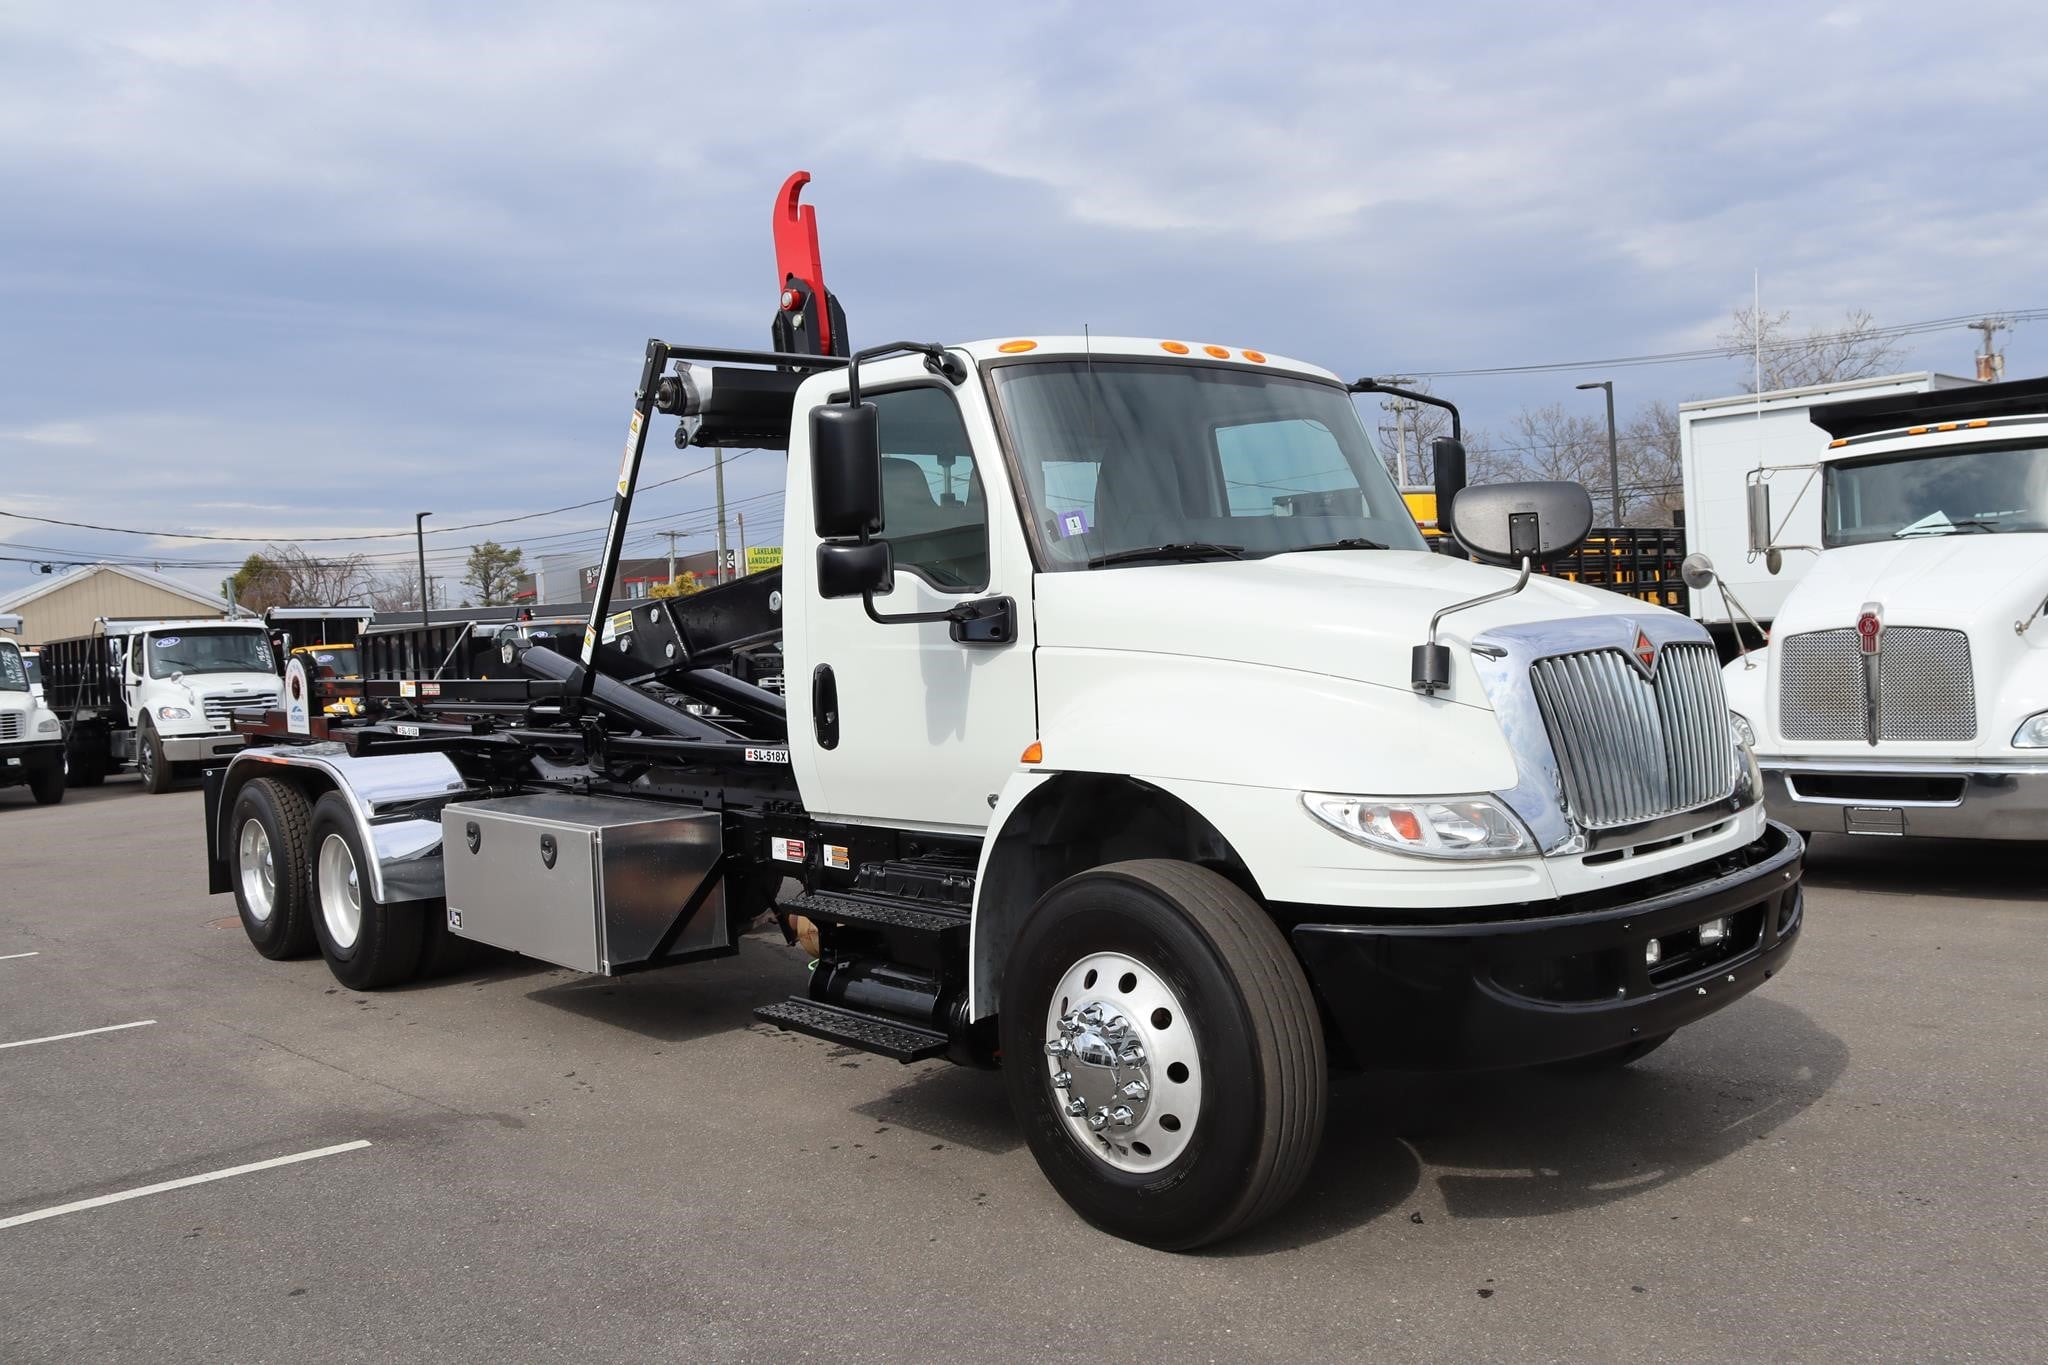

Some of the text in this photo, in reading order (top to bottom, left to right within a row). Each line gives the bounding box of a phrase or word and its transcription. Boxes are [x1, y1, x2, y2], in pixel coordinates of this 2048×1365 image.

[753, 547, 781, 555] LAKELAND
[748, 556, 780, 564] LANDSCAPE
[753, 750, 787, 762] SL-518X
